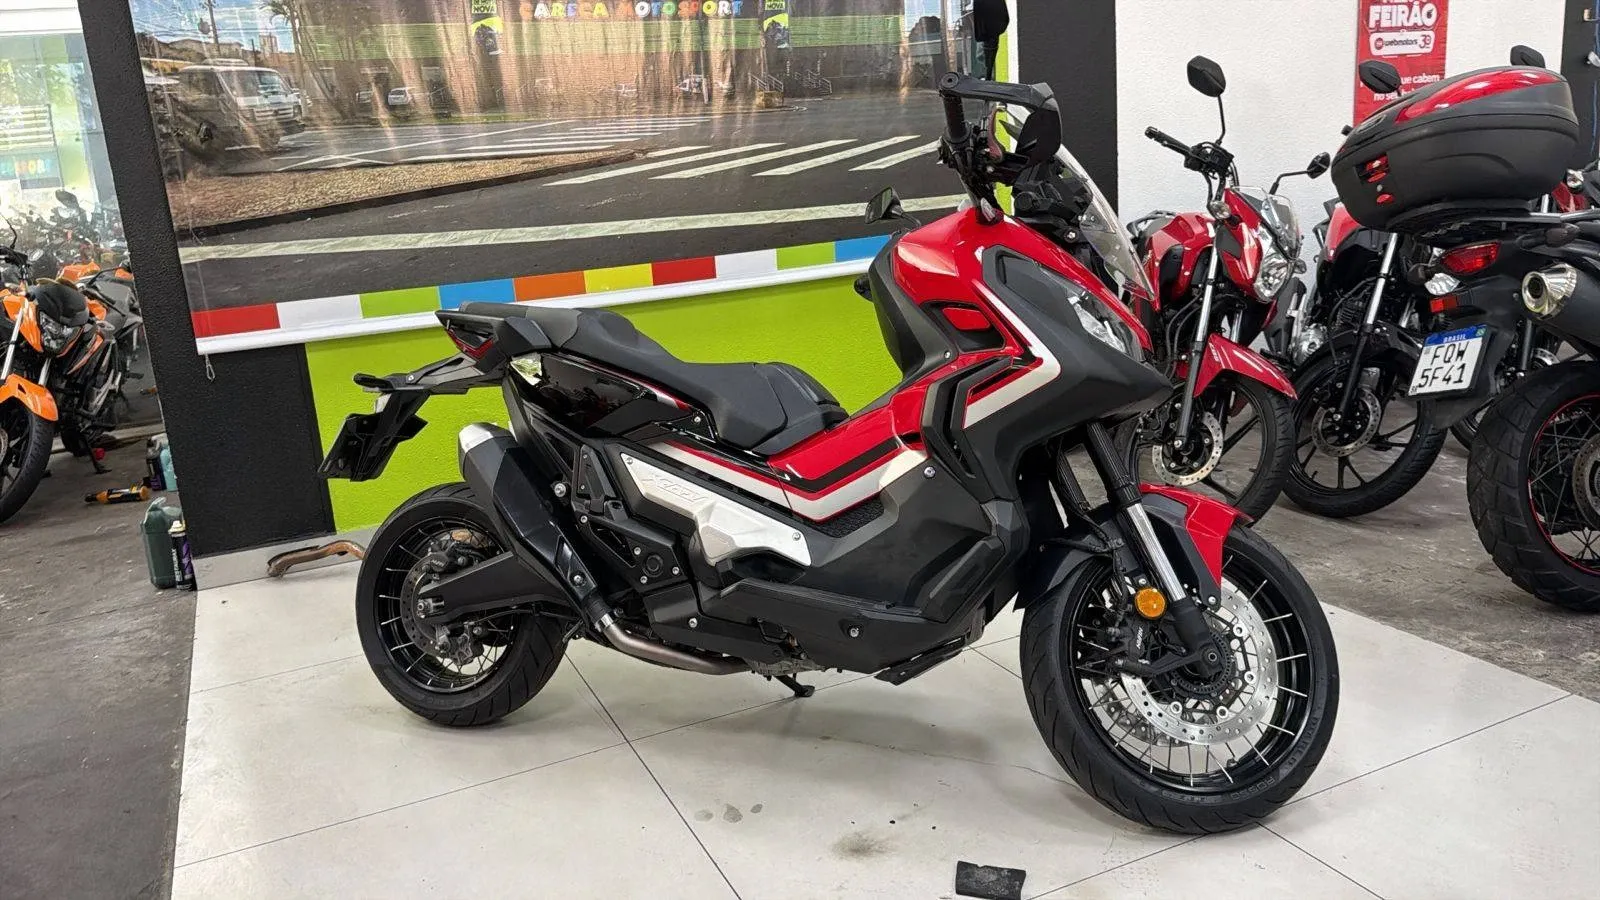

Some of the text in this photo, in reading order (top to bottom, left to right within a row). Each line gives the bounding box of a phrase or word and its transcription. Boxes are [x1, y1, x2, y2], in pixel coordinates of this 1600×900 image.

[1369, 1, 1438, 28] FEIRÃO
[1413, 72, 1440, 83] cabem
[1418, 363, 1466, 388] 5F41
